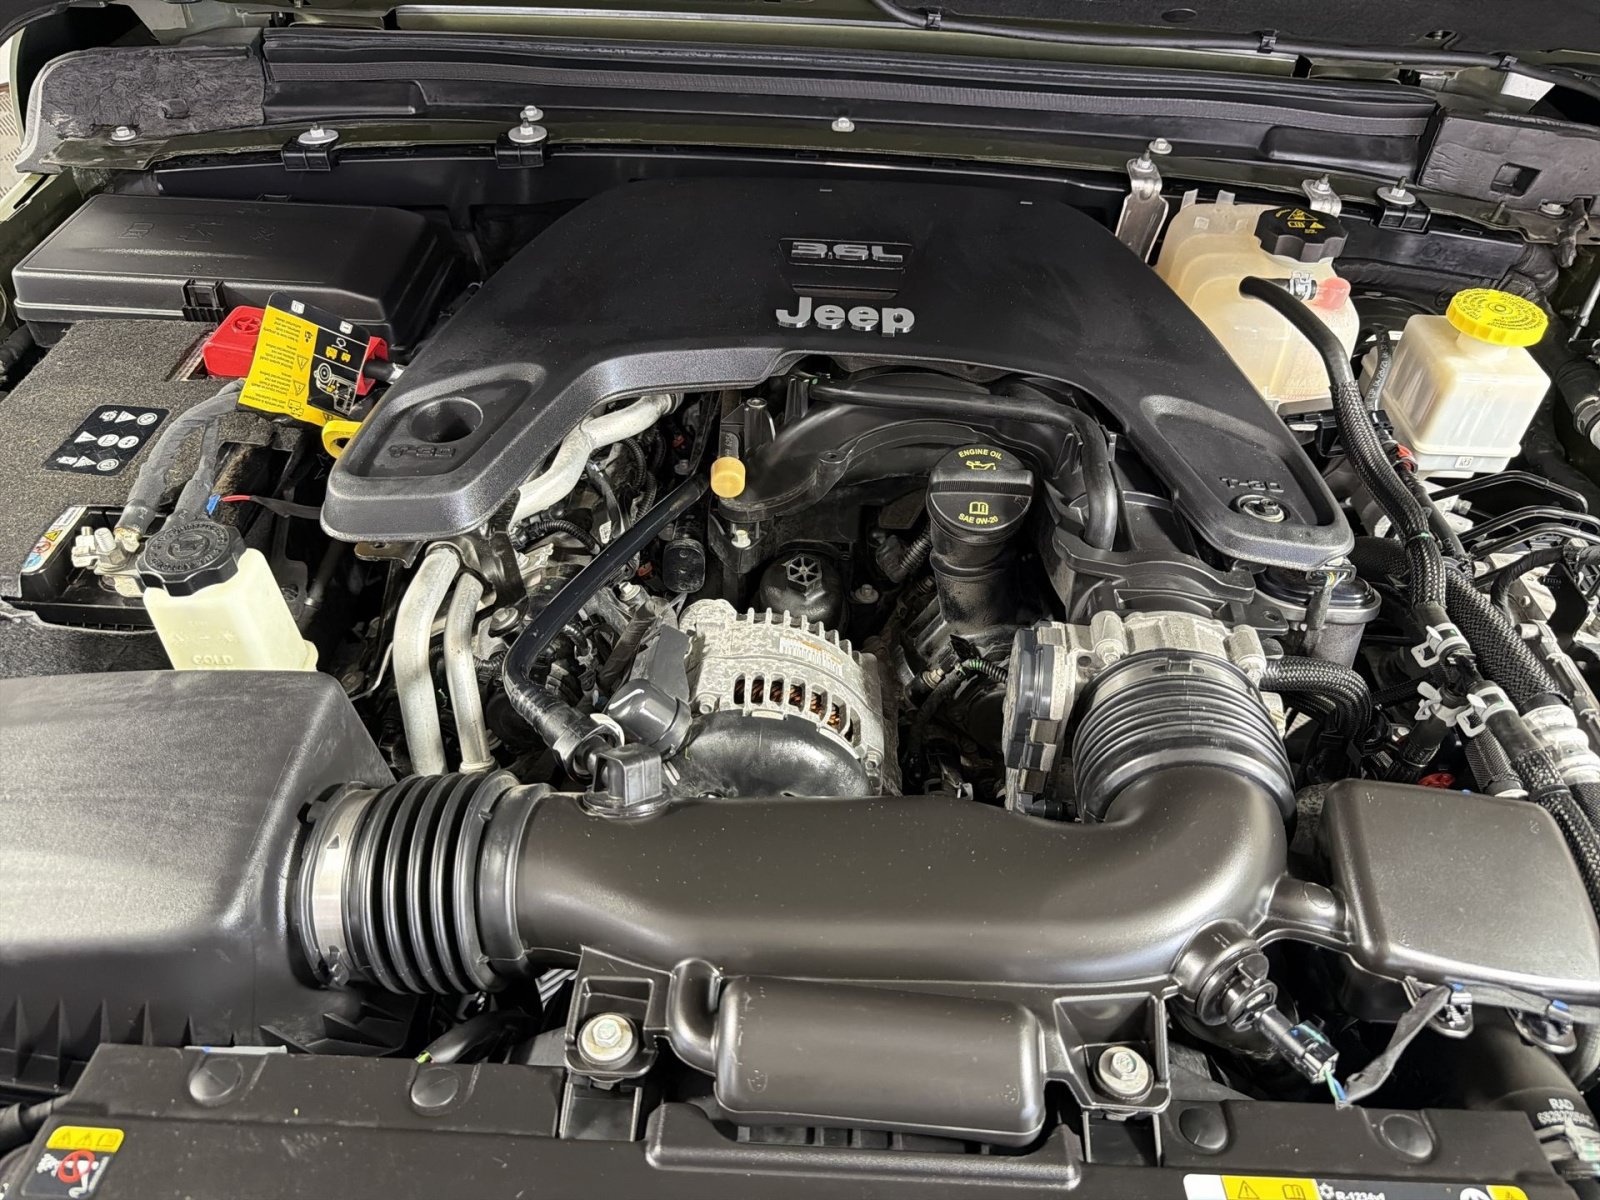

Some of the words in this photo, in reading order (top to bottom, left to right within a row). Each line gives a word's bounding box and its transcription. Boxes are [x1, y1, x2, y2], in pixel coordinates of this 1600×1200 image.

[791, 241, 903, 262] 3.6L
[775, 296, 915, 337] Jeep
[958, 448, 989, 458] ENGINE
[990, 450, 1002, 460] OIL
[958, 513, 974, 524] SAE
[1548, 1098, 1575, 1111] RAD
